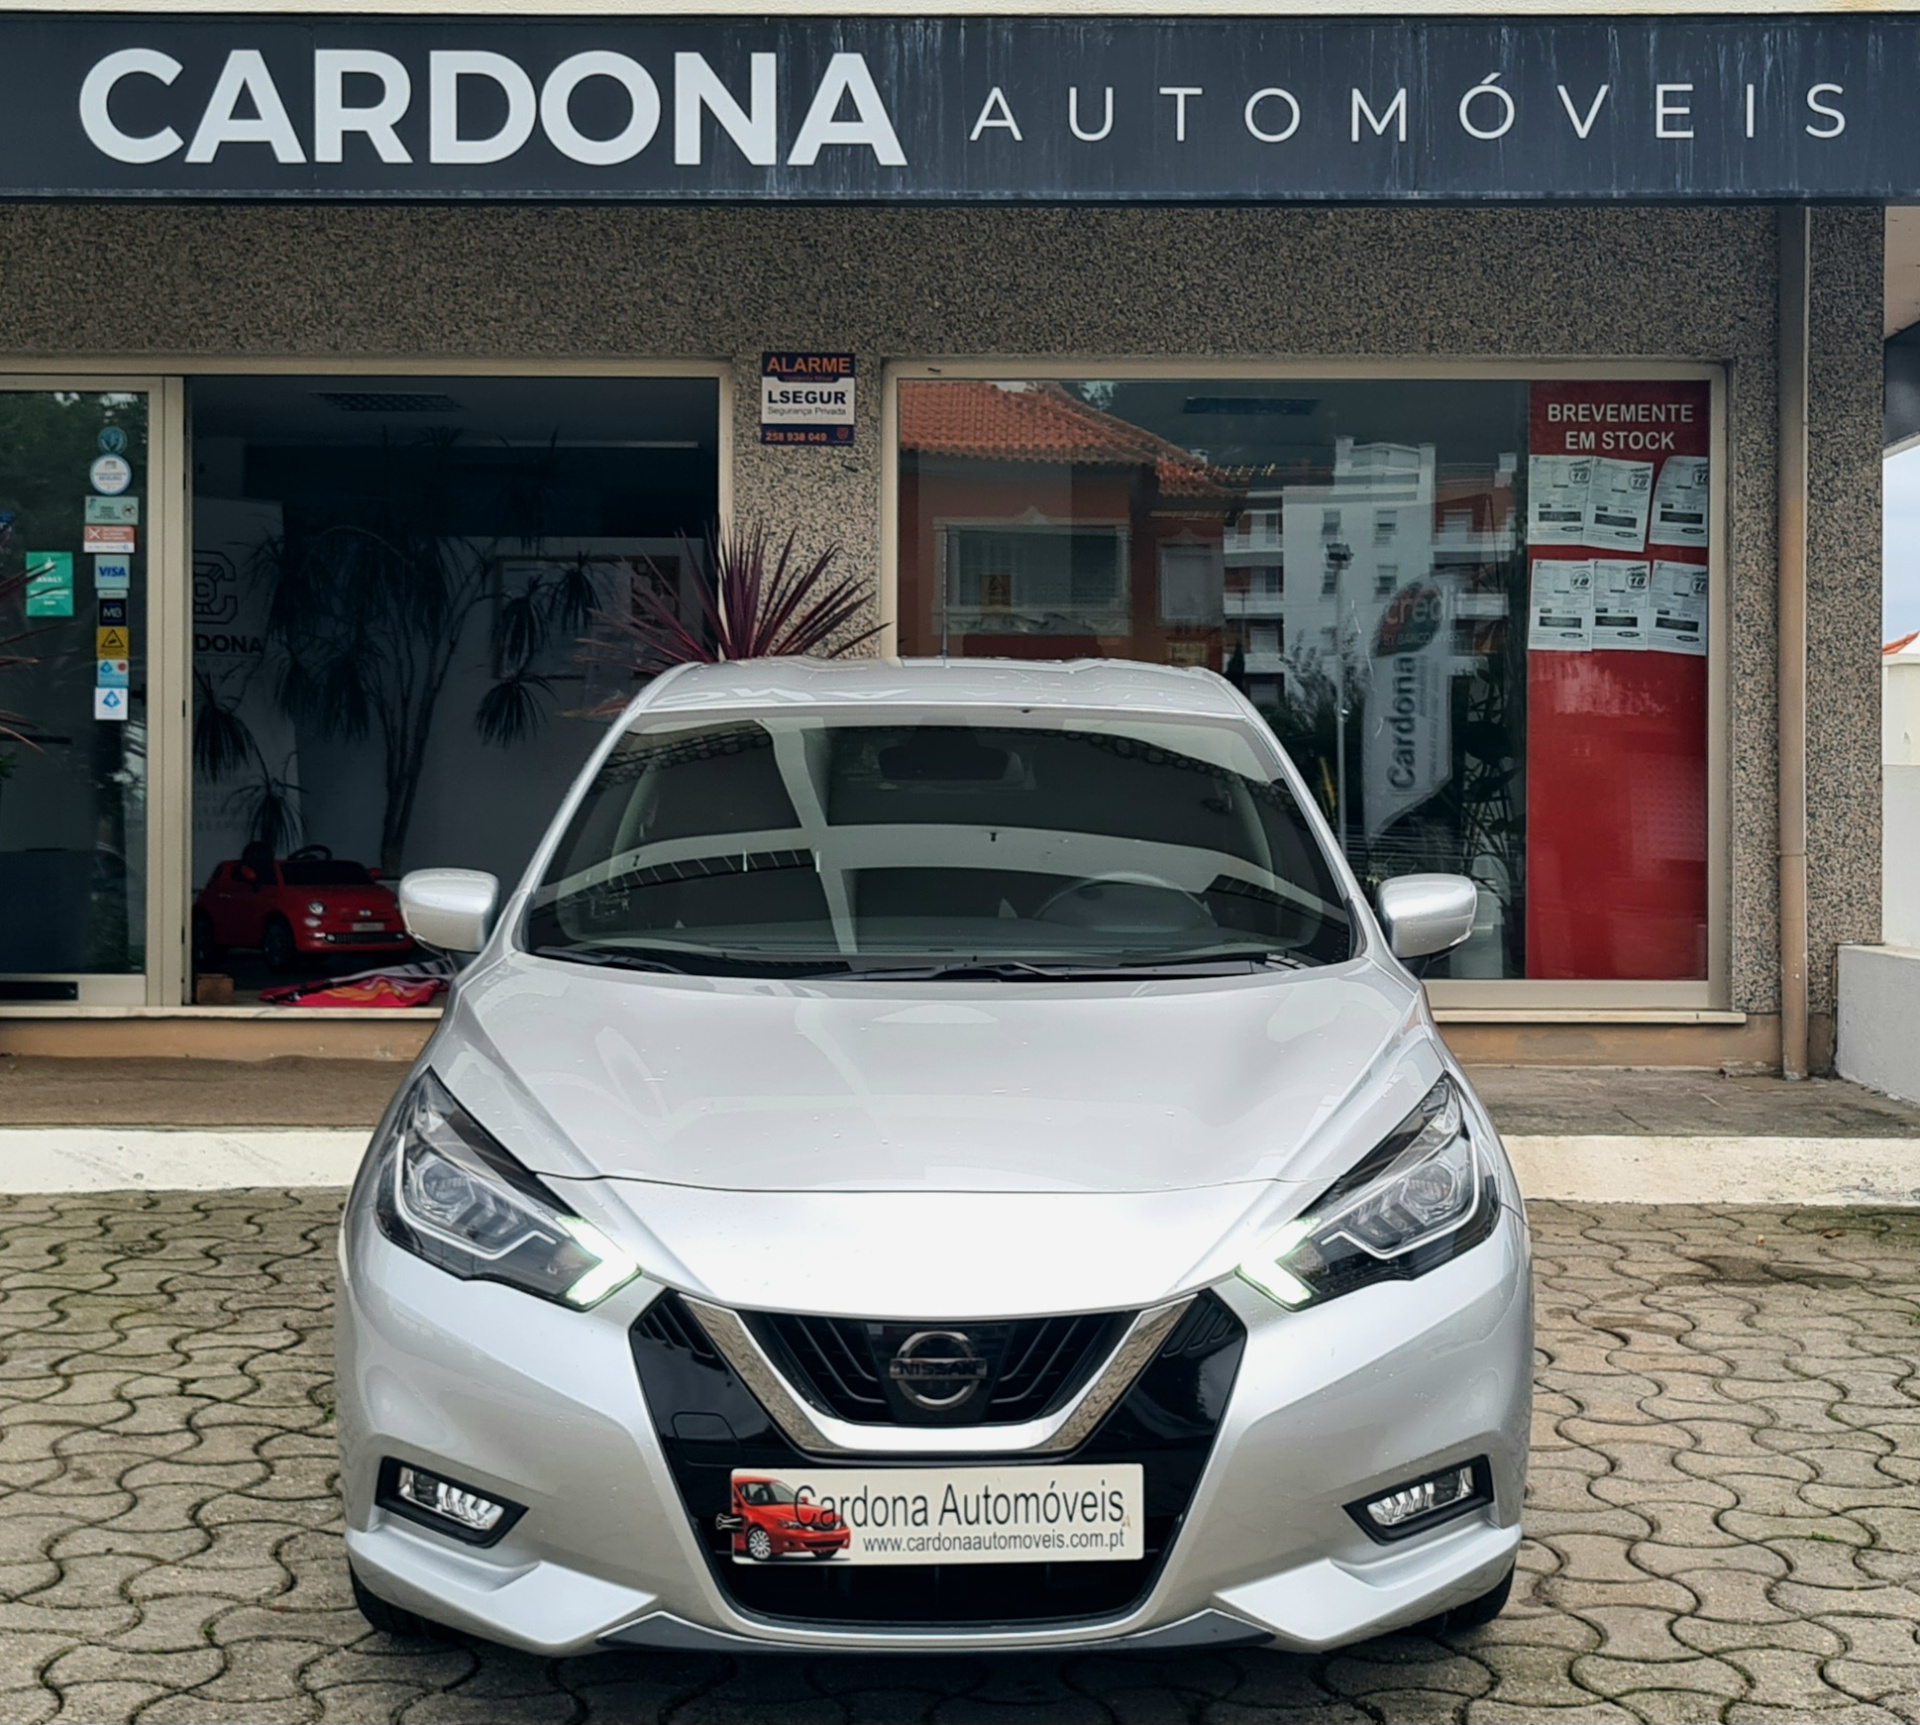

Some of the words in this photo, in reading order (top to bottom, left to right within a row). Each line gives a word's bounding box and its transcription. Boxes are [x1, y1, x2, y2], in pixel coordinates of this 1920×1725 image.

[79, 48, 908, 166] CARDONA
[970, 73, 1848, 144] AUTOMÓVEIS
[767, 357, 851, 373] ALARME
[768, 390, 847, 404] LSEGUR
[767, 406, 812, 416] Segurança
[815, 407, 846, 416] Privada
[1548, 404, 1694, 423] BREVEMENTE
[1565, 431, 1595, 450] EM
[1601, 431, 1675, 450] STOCK
[99, 566, 126, 578] VISA
[103, 606, 122, 618] MB
[195, 634, 264, 653] DONA
[1387, 657, 1416, 790] Cardona
[899, 1362, 977, 1375] NISSAN
[794, 1484, 929, 1528] Cardona
[939, 1479, 1125, 1527] Automóveis
[863, 1529, 1125, 1553] www.cardonaautomoveis.com.pt
